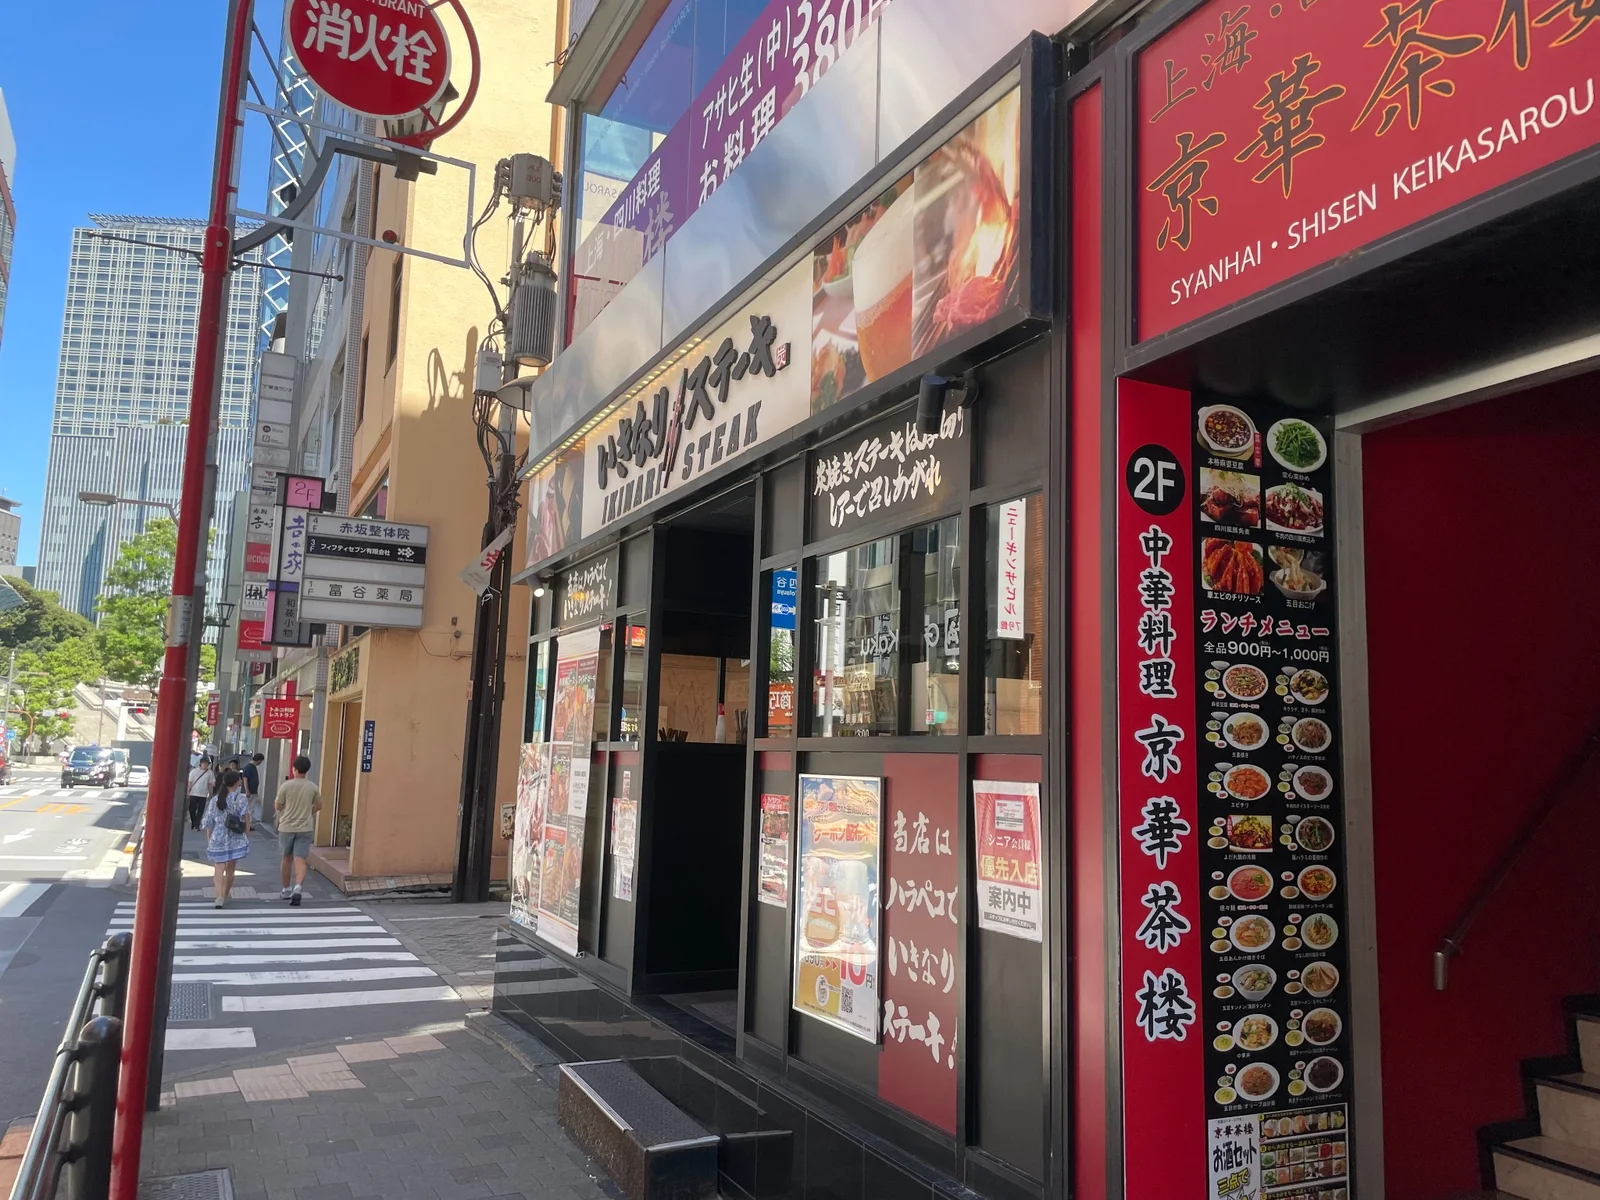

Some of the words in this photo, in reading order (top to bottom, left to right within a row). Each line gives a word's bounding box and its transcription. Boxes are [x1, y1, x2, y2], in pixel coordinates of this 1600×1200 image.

[303, 0, 437, 85] 消火栓
[702, 5, 791, 150] アサヒ生(中)
[698, 85, 776, 208] お料理
[1170, 241, 1261, 305] SYANHAI
[1287, 183, 1378, 250] SHISEN
[1393, 78, 1596, 200] KEIKASAROU
[681, 399, 762, 481] STEAK
[294, 481, 316, 502] 2F
[1133, 456, 1176, 502] 2F
[309, 538, 316, 552] 3F
[339, 522, 410, 540] 赤坂整体院
[328, 583, 413, 602] 富谷薬局
[1138, 524, 1177, 700] 中華料理
[1286, 598, 1316, 611] 五目おこげ
[283, 598, 296, 638] 和装小物
[1200, 608, 1330, 641] ランチメニュー
[1230, 801, 1250, 809] エビチリ
[893, 809, 952, 856] 当店は
[987, 833, 1031, 851] シニア会員様
[980, 854, 1038, 886] 優先入店
[1132, 712, 1196, 1042] 京華茶楼
[885, 876, 959, 924] ハラペコで
[988, 885, 1031, 916] 案内中
[888, 935, 955, 994] いきなり
[1213, 1137, 1258, 1173] お酒セット
